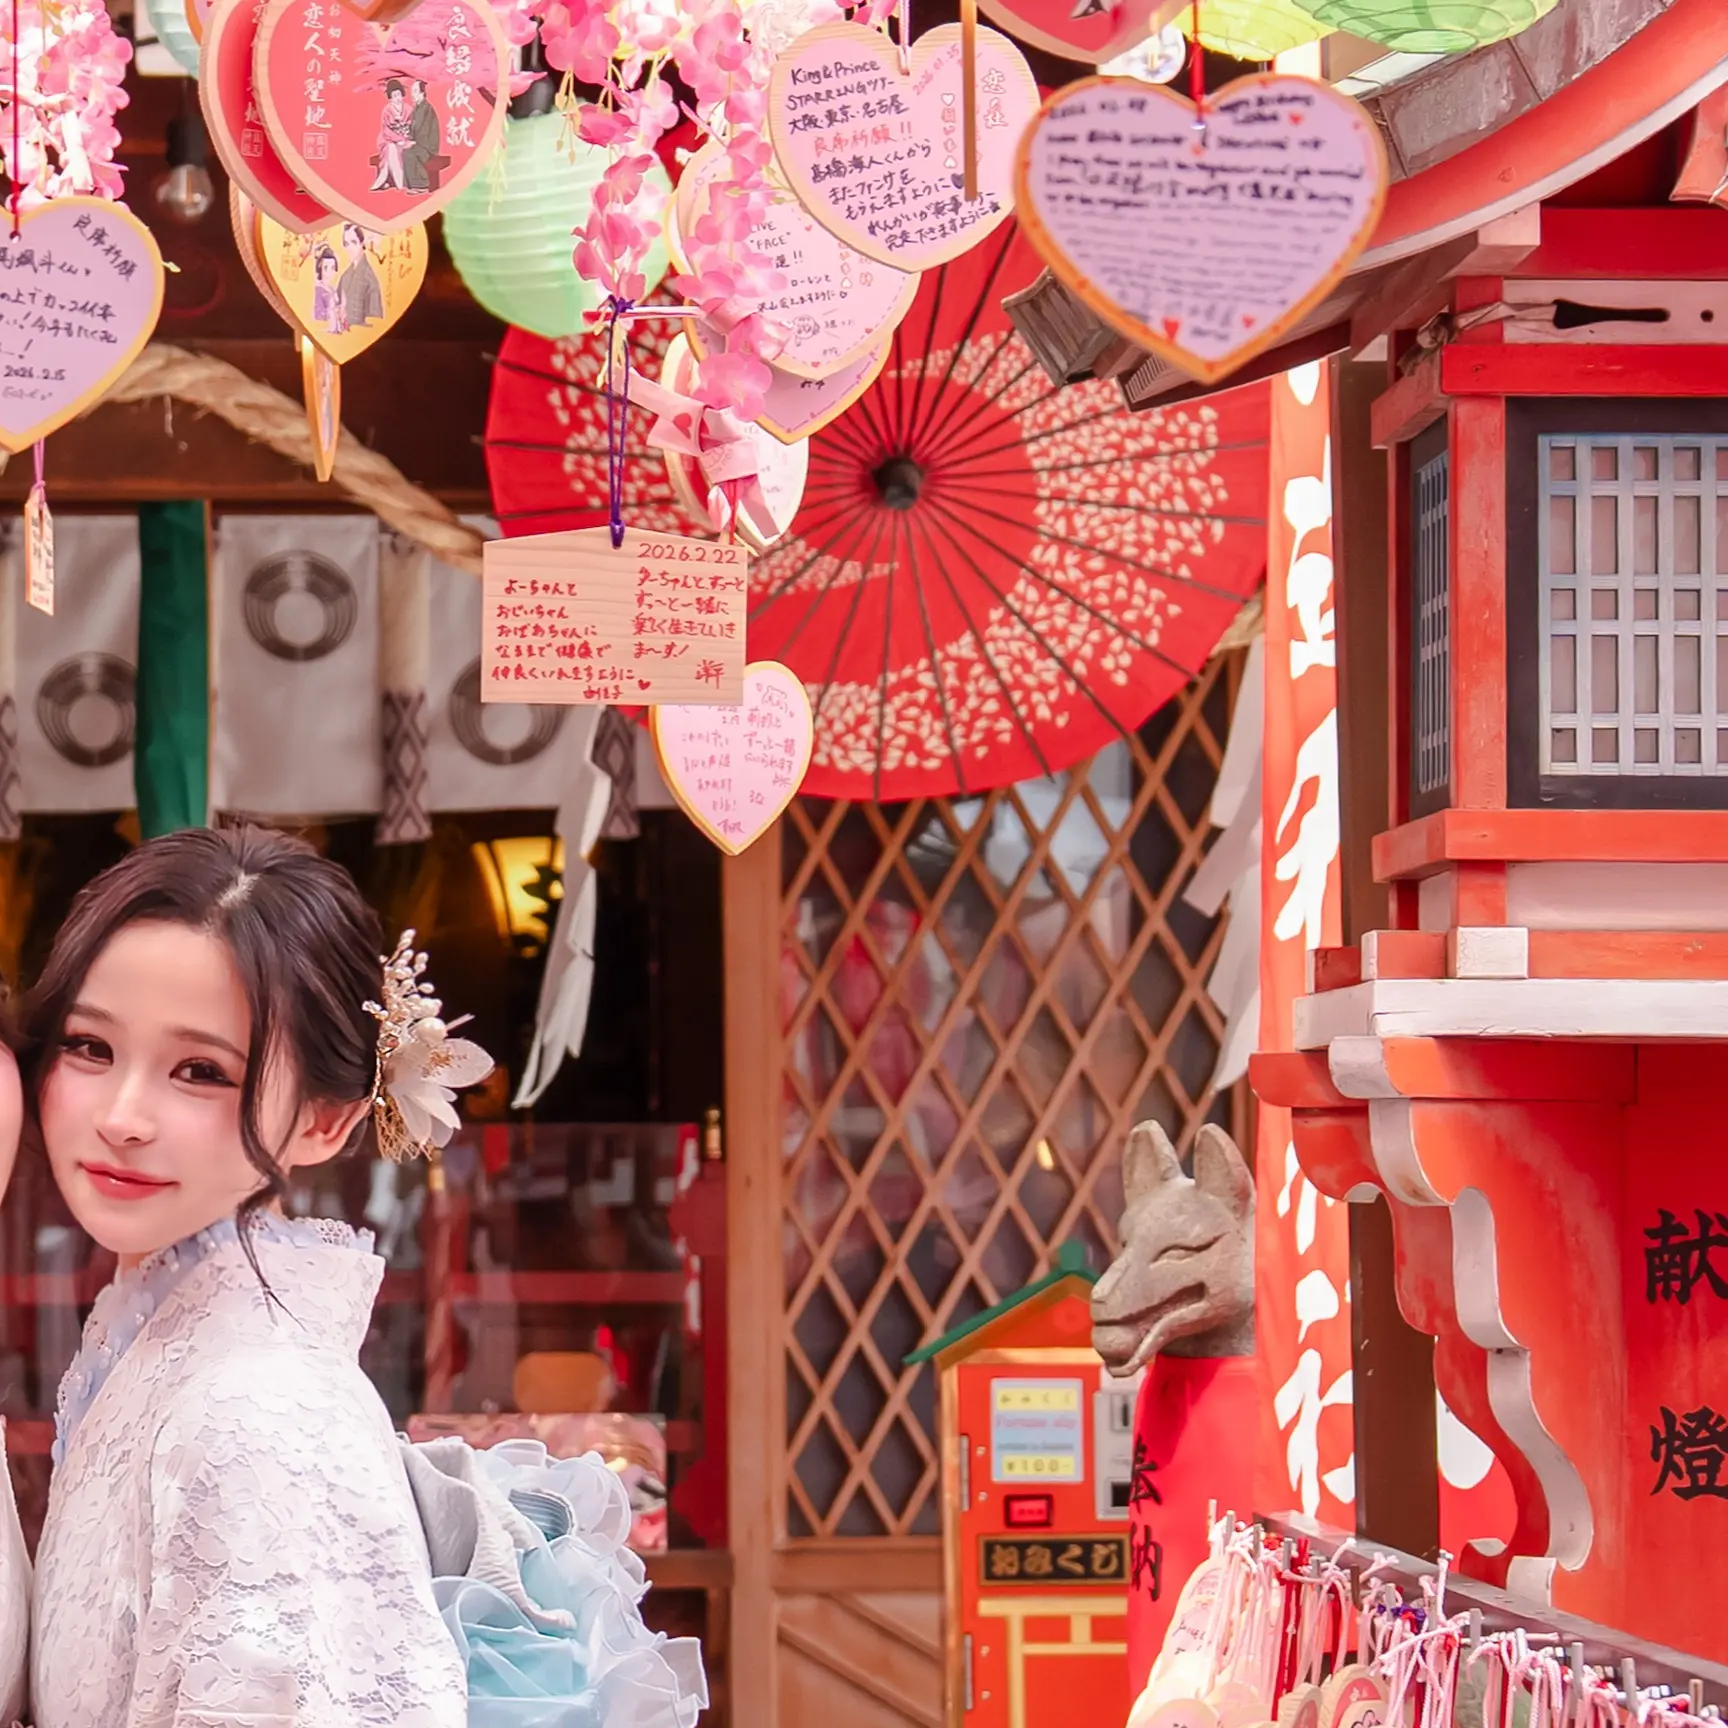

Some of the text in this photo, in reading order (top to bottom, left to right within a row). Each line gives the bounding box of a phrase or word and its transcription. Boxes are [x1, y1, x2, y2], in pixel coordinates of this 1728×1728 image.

[303, 1, 333, 129] 恋人の聖地
[444, 6, 476, 148] 良縁成就
[638, 542, 739, 565] 2026.2.22
[990, 1542, 1121, 1577] おみくじ
